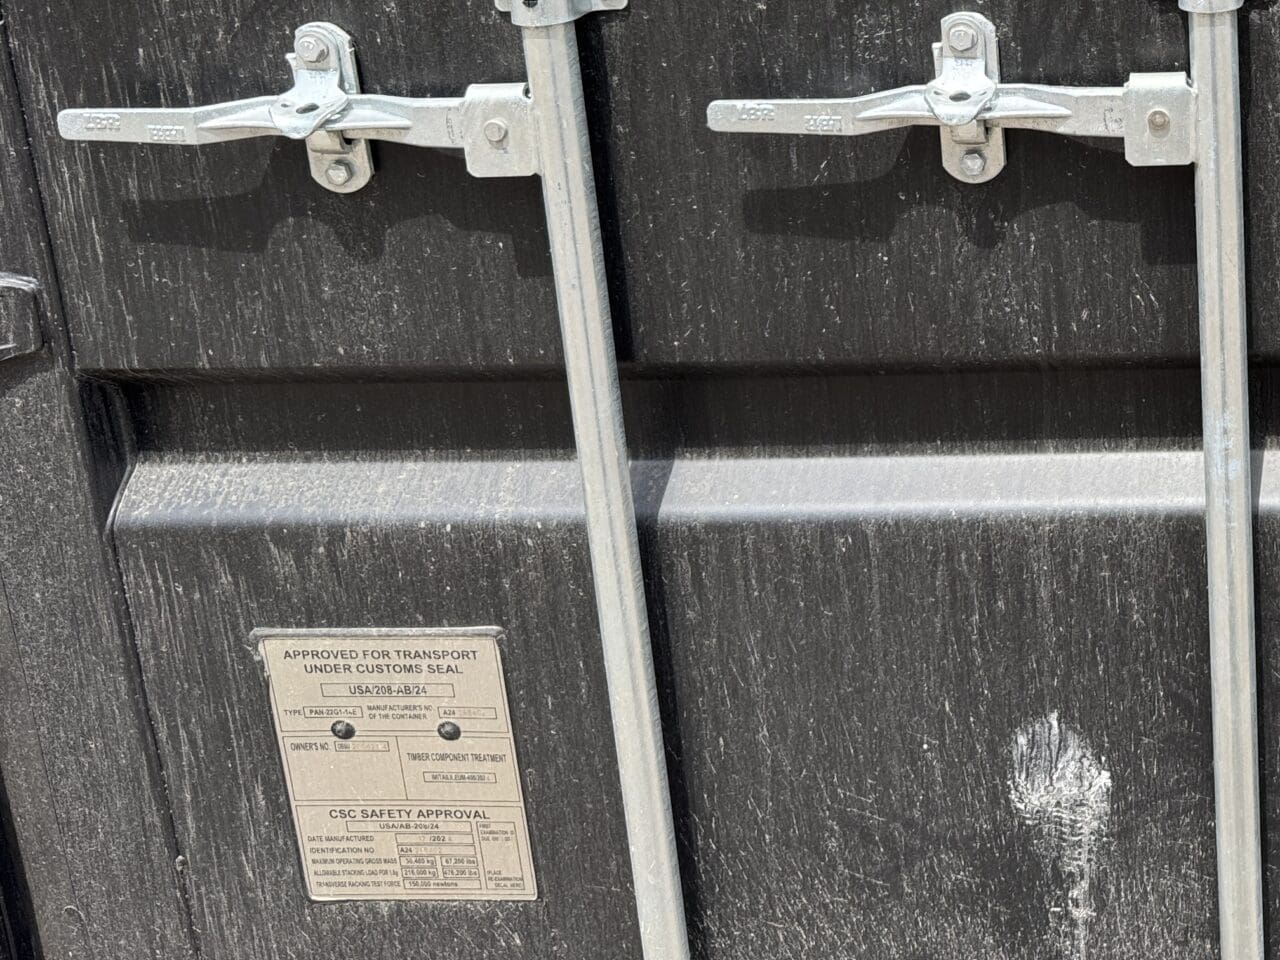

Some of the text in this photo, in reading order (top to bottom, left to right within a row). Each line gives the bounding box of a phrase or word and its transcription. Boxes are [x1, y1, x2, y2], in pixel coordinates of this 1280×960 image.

[283, 649, 479, 660] APPROVED FOR TRANSPORT
[304, 663, 464, 674] UNDER CUSTOMS SEAL
[348, 685, 428, 696] USA/208-AB/24
[407, 752, 507, 763] TIMBER COMPONENT TREATMENT
[329, 809, 491, 820] CSC SAFETY APPROVAL
